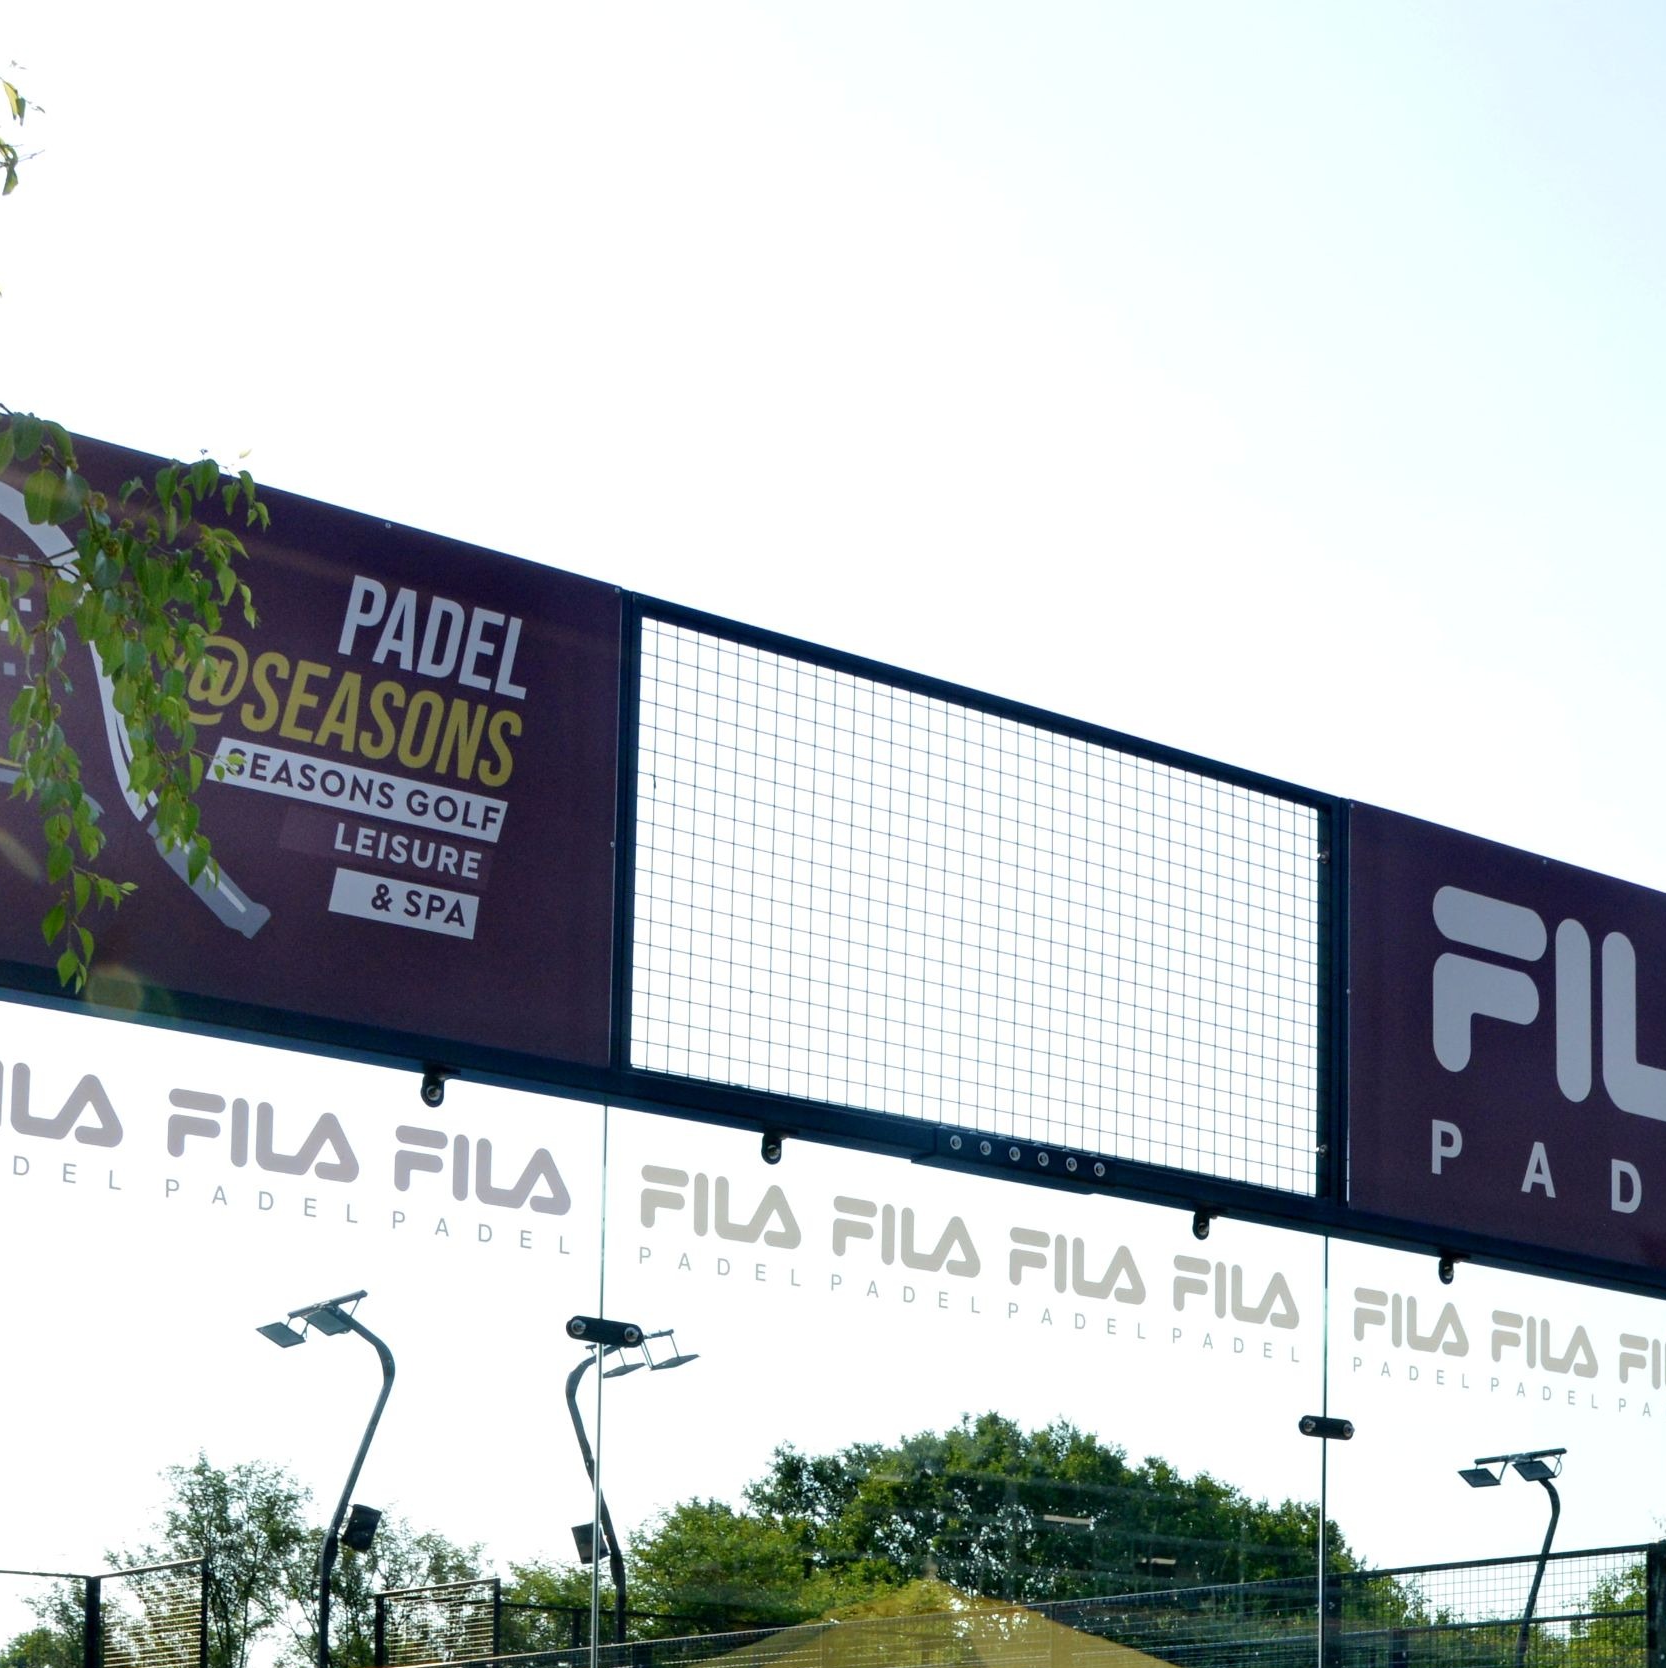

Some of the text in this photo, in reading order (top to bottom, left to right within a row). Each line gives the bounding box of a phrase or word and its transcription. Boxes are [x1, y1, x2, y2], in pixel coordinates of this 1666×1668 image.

[338, 575, 528, 700] PADEL
[179, 634, 523, 787] @SEASONS
[223, 746, 502, 836] SEASONS GOLF
[334, 822, 481, 879] LEISURE
[370, 880, 466, 928] & SPA
[167, 1088, 360, 1182] FILA
[395, 1125, 571, 1215] FILA
[166, 1177, 358, 1224] PADEL
[392, 1211, 571, 1255] PADEL
[641, 1165, 1300, 1330] FILA FILA FILA FILA
[640, 1246, 1300, 1363] PADEL PADEL PADEL PADEL
[1354, 1286, 1469, 1357] FILA
[1491, 1309, 1598, 1378] FILA
[1353, 1357, 1469, 1389] PADEL
[1491, 1377, 1598, 1409] PADEL
